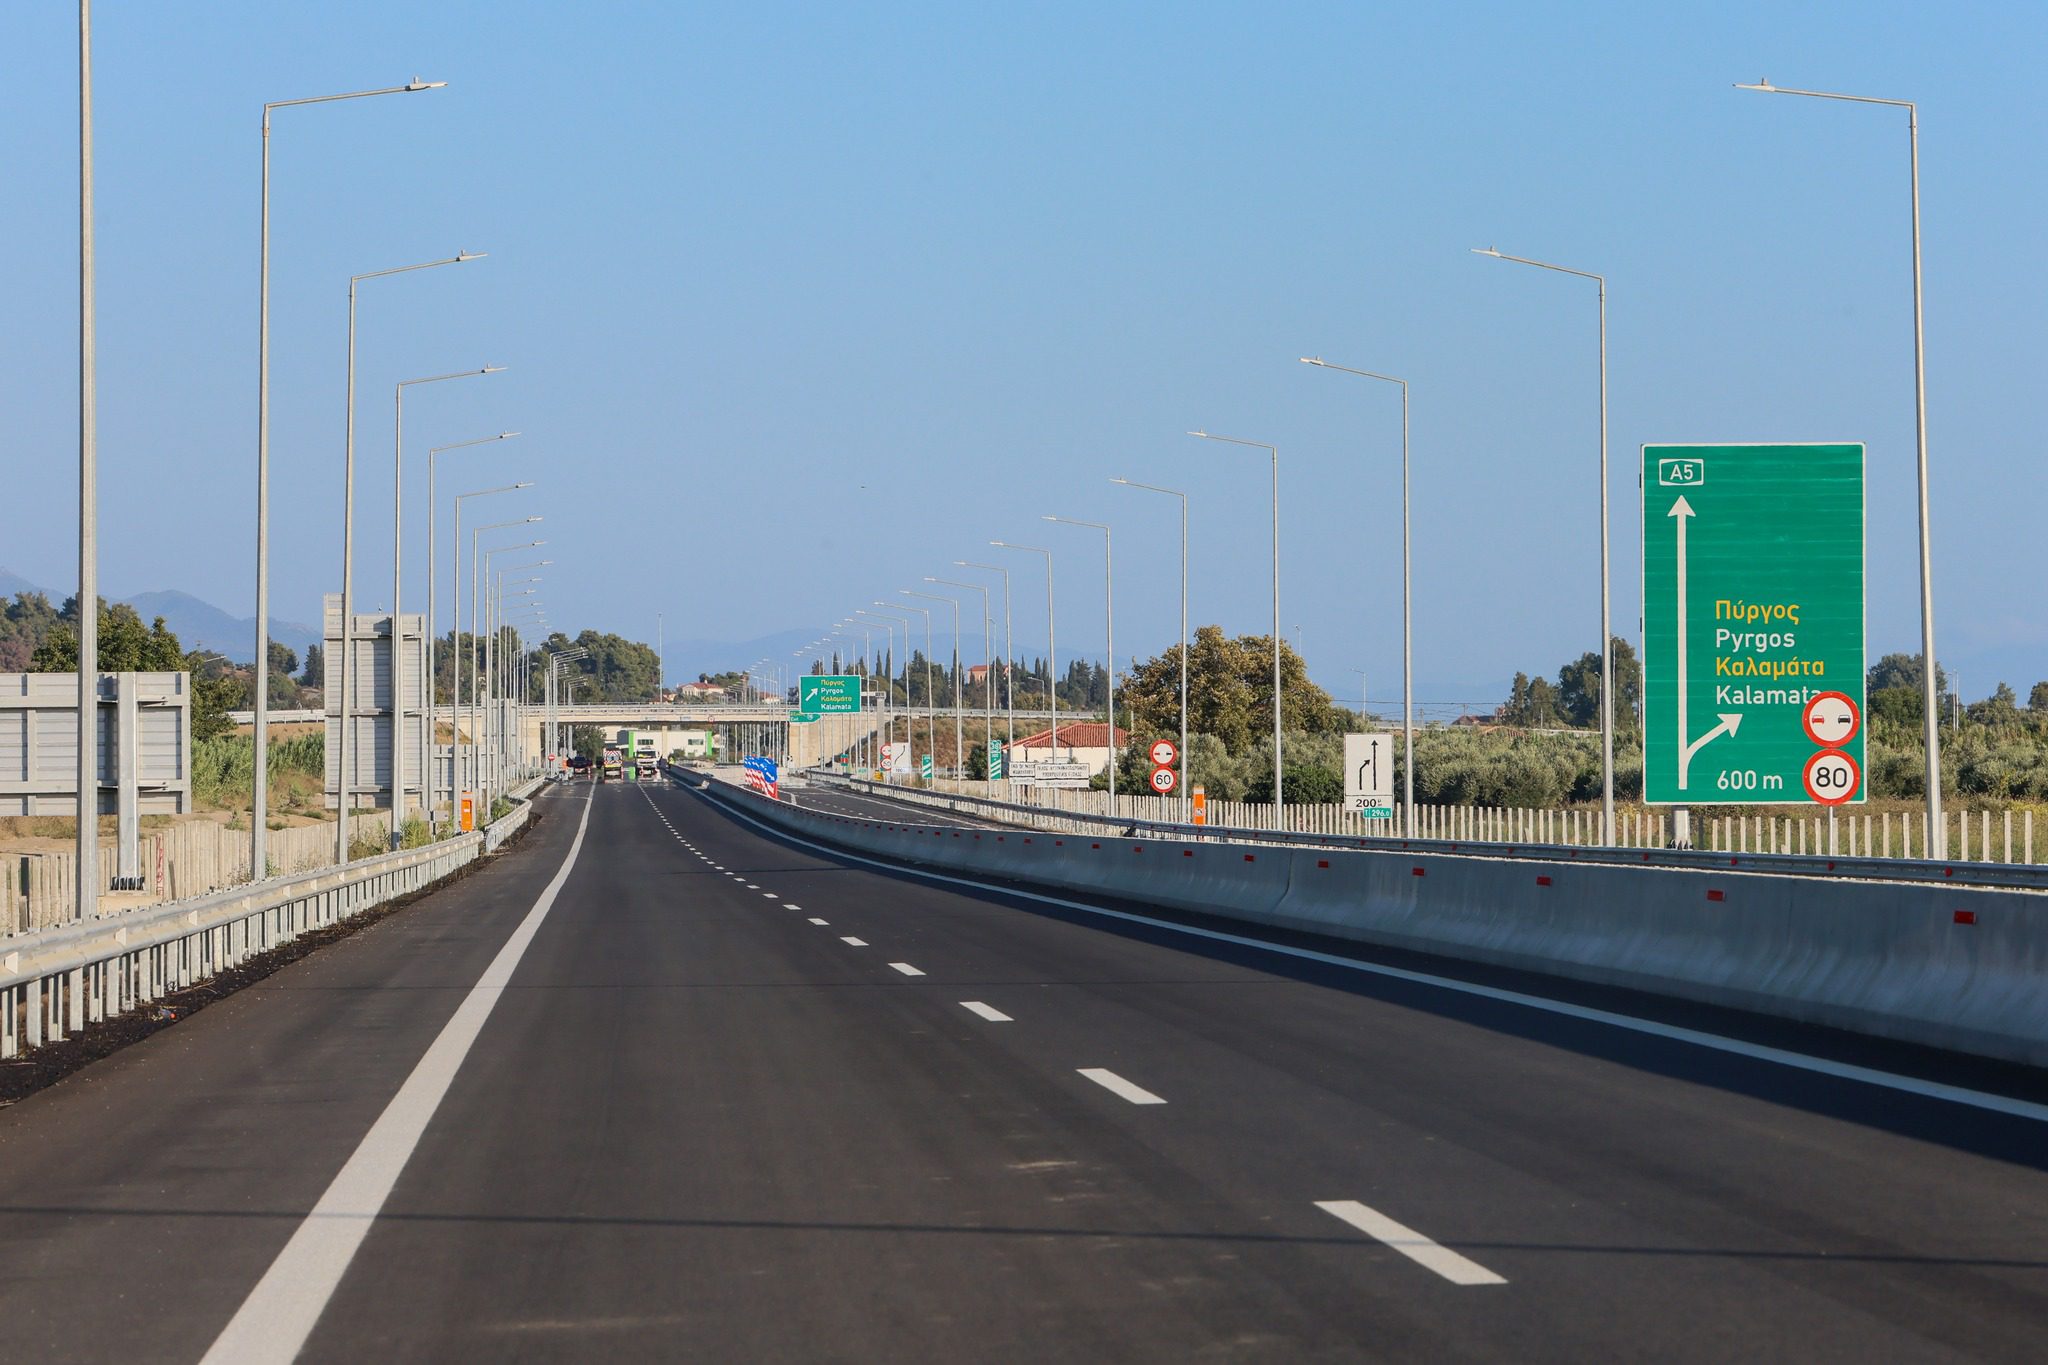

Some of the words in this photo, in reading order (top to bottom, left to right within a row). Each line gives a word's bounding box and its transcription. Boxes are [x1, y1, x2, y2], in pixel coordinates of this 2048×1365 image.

[1670, 464, 1693, 480] A5
[1715, 600, 1800, 625] Πύργος
[1716, 629, 1796, 652] Pyrgos
[1716, 657, 1824, 681] Καλαμάτα
[1156, 774, 1171, 785] 60
[1717, 770, 1757, 790] 600
[1763, 775, 1783, 790] m
[1816, 766, 1847, 788] 80
[1356, 798, 1377, 807] 200
